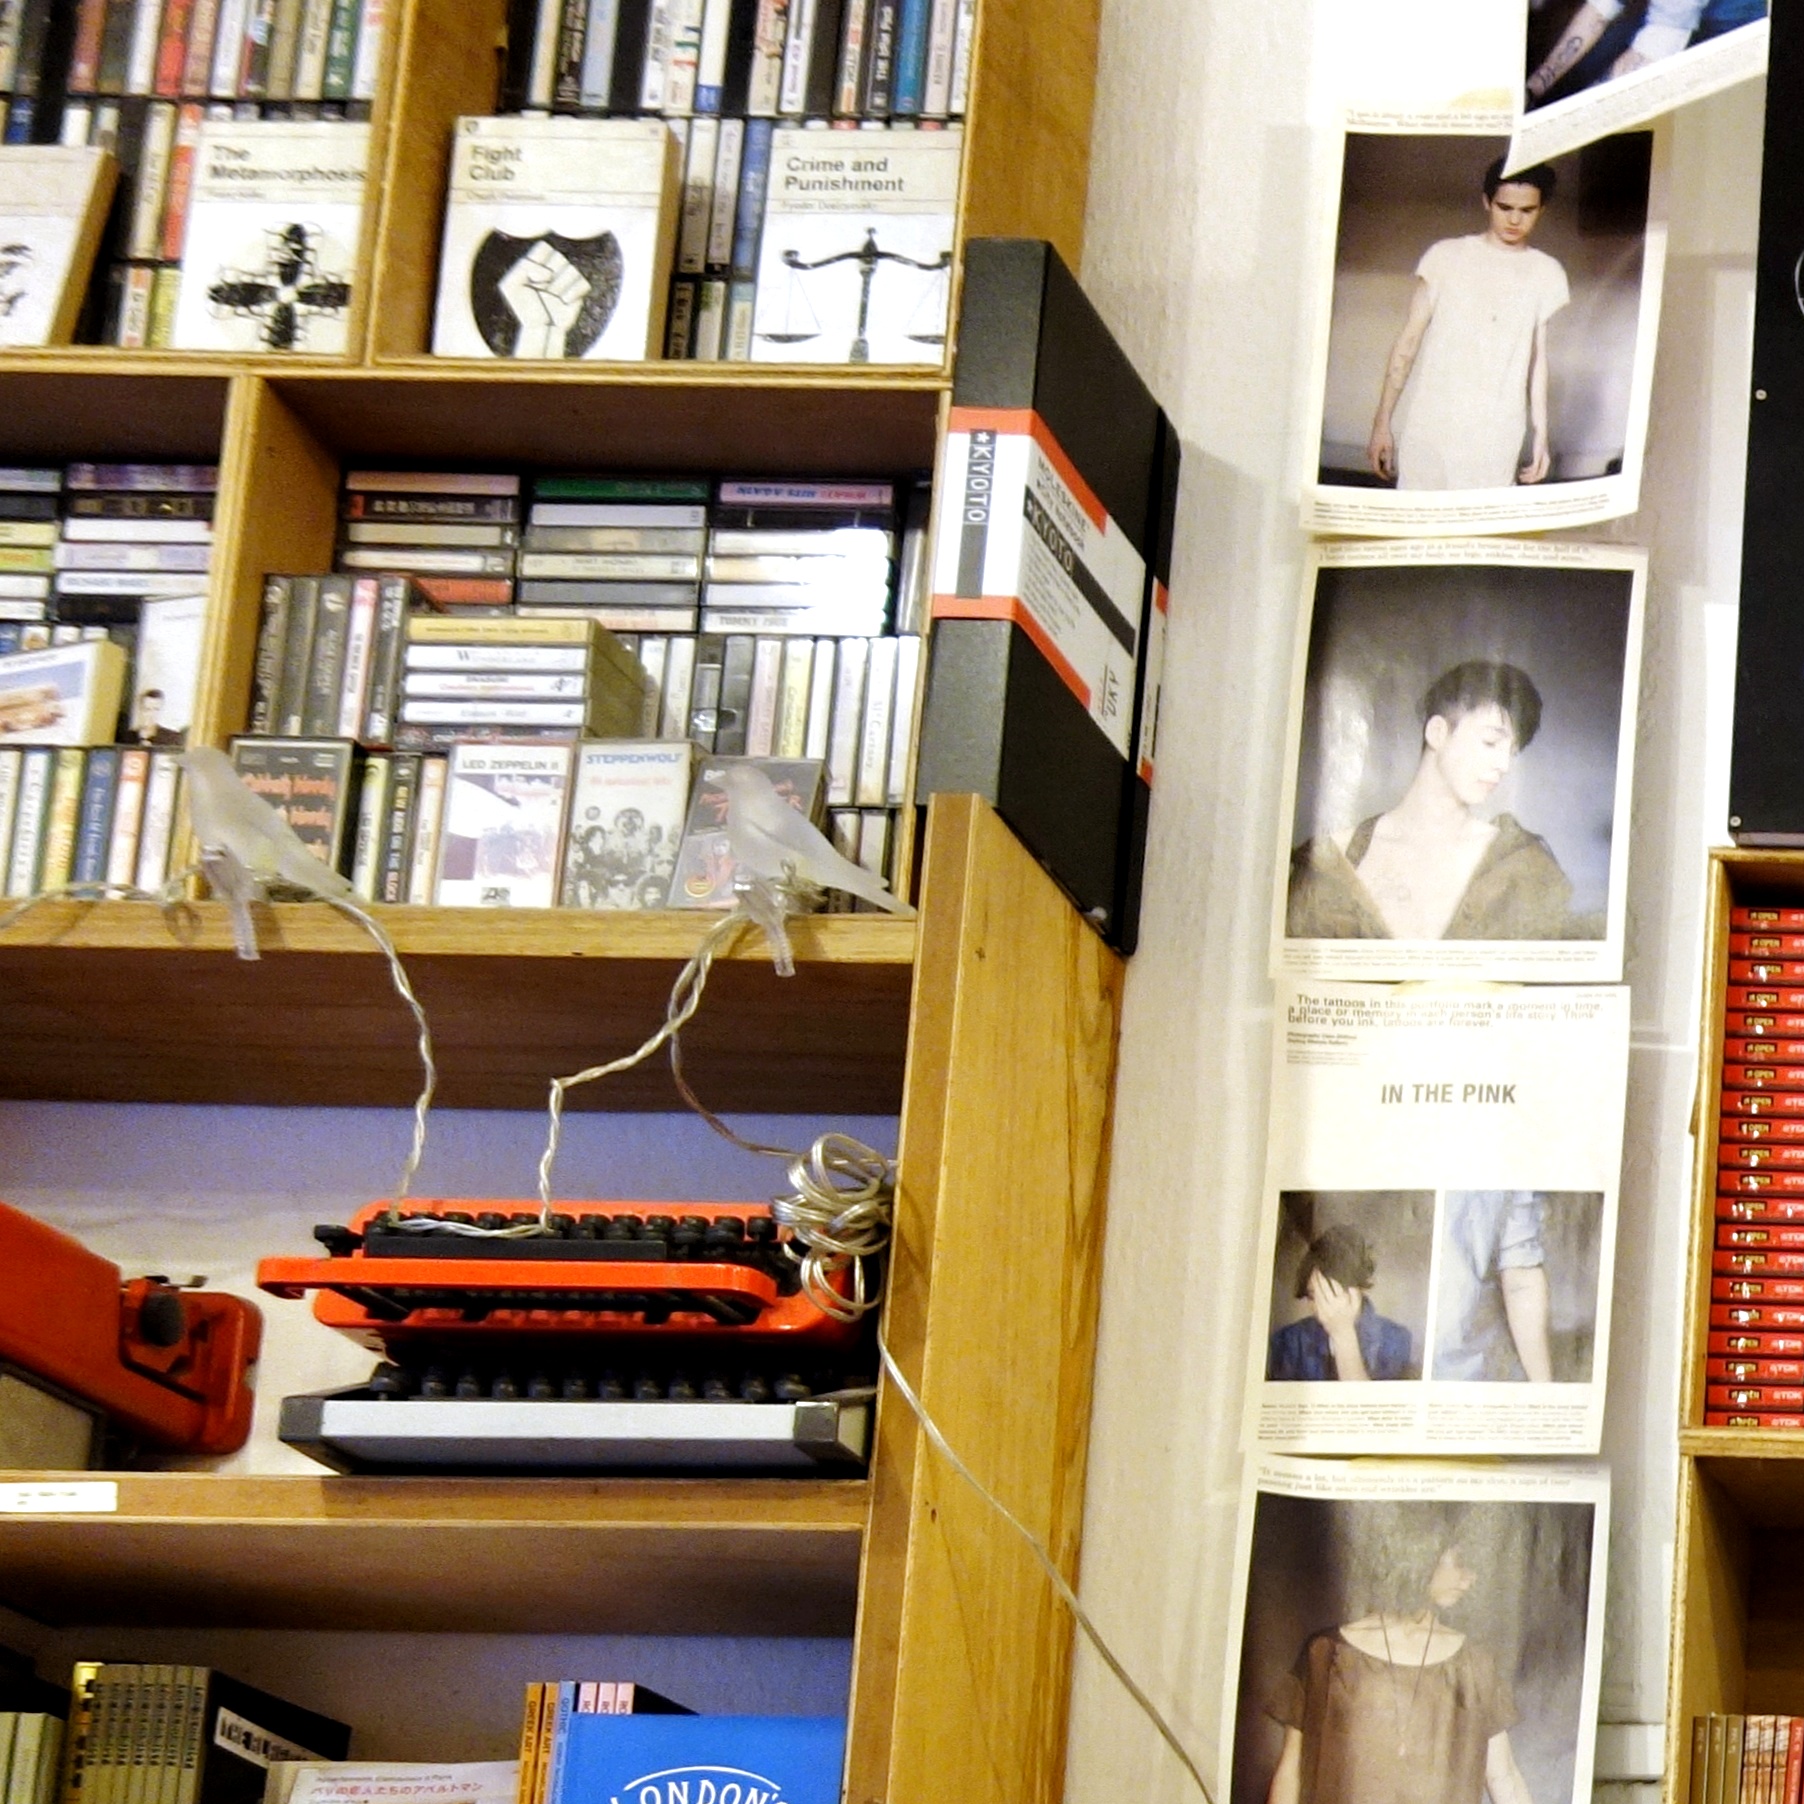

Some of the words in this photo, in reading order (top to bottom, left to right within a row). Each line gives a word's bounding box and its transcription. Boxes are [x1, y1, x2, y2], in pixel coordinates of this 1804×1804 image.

[213, 146, 249, 160] The
[471, 145, 522, 163] Fight
[787, 157, 845, 172] Crime
[851, 158, 888, 172] and
[210, 165, 367, 182] Metamorphosis
[470, 165, 515, 181] Club
[784, 176, 904, 192] Punishment
[967, 443, 993, 524] KYOTO
[463, 759, 487, 770] LED
[492, 759, 547, 771] ZEPPELIN
[586, 753, 681, 765] STEPPENWOLF
[1297, 995, 1319, 1005] The
[1382, 1085, 1402, 1103] IN
[1413, 1084, 1453, 1103] THE
[1463, 1084, 1516, 1104] PINK
